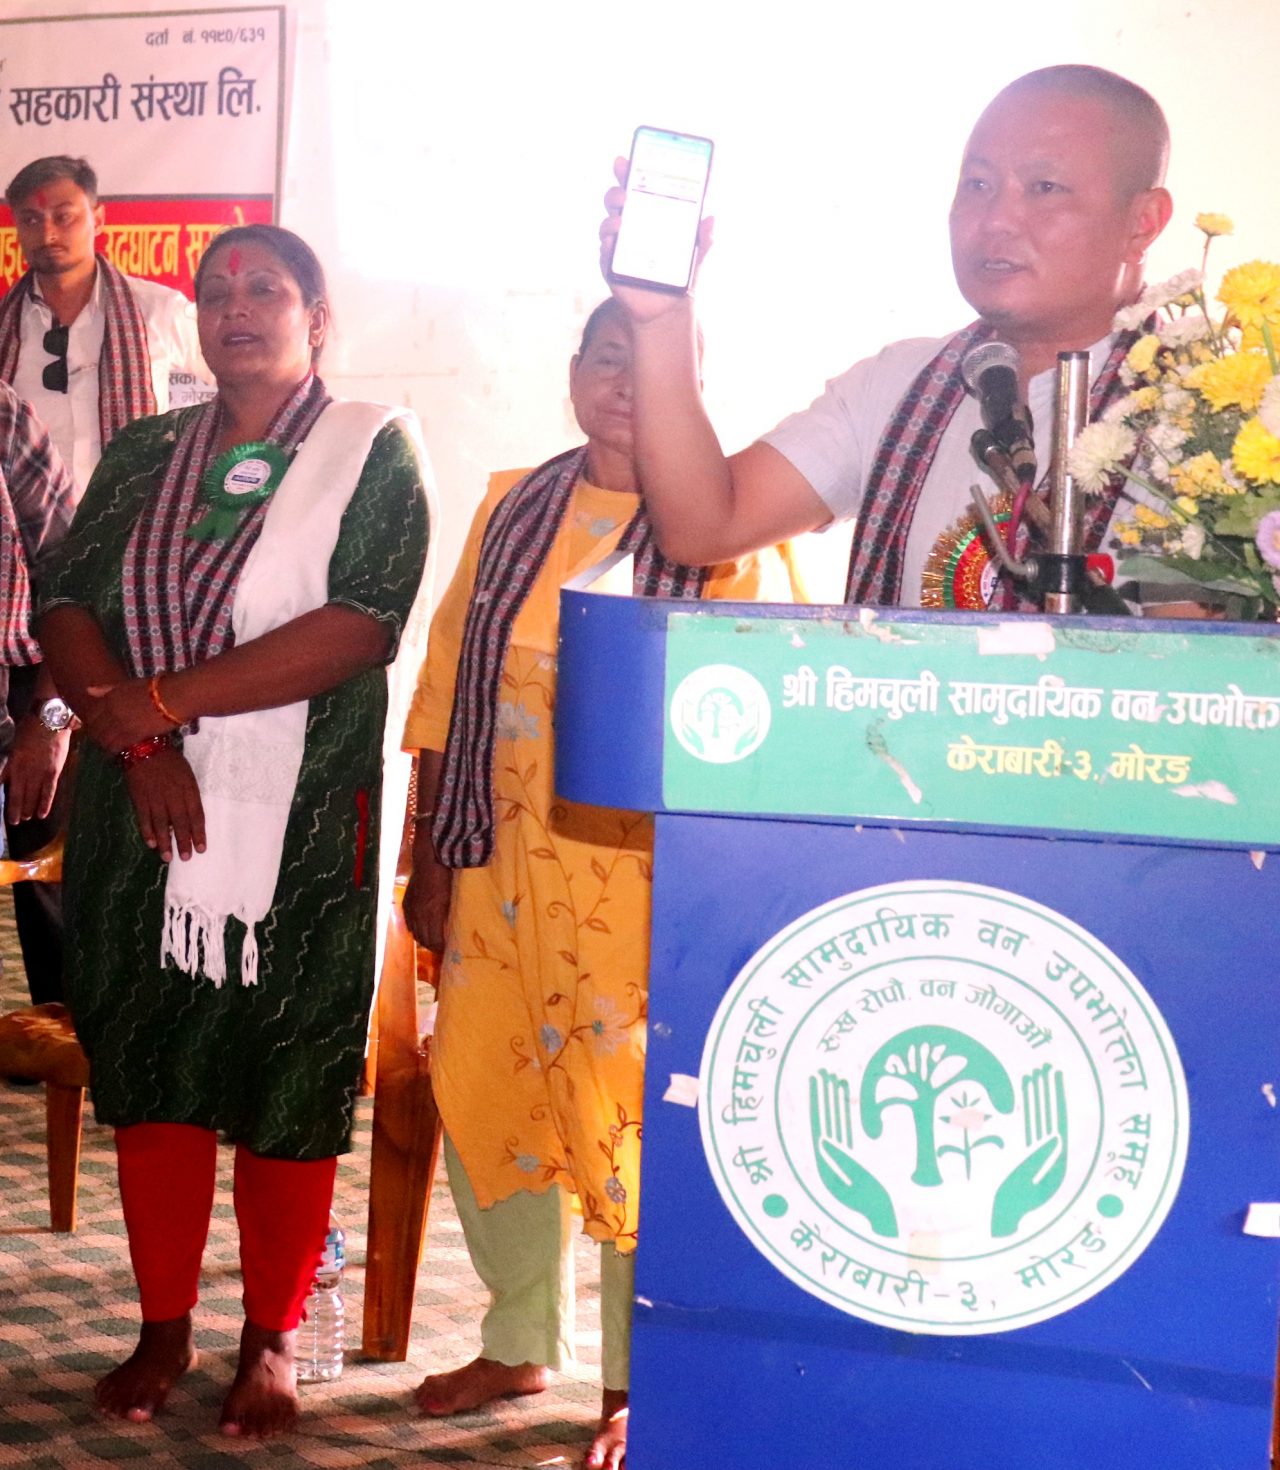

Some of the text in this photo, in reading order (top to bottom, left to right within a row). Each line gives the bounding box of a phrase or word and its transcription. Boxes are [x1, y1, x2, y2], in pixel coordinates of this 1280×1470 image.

[8, 72, 121, 126] सहकारी
[131, 74, 208, 122] संस्था
[216, 66, 261, 118] लि.
[782, 665, 818, 708] श्री
[826, 665, 940, 720] हिमचुली
[948, 674, 1104, 726] सामुदायिक
[1111, 688, 1160, 722] वन
[1111, 744, 1192, 784] मोरङ
[780, 907, 954, 989] सामुदायिक
[977, 917, 1030, 958] वन
[919, 979, 957, 999] वन
[722, 995, 786, 1127] हिमचुली
[732, 1144, 774, 1186] श्री
[1014, 1221, 1107, 1288] मोरङ
